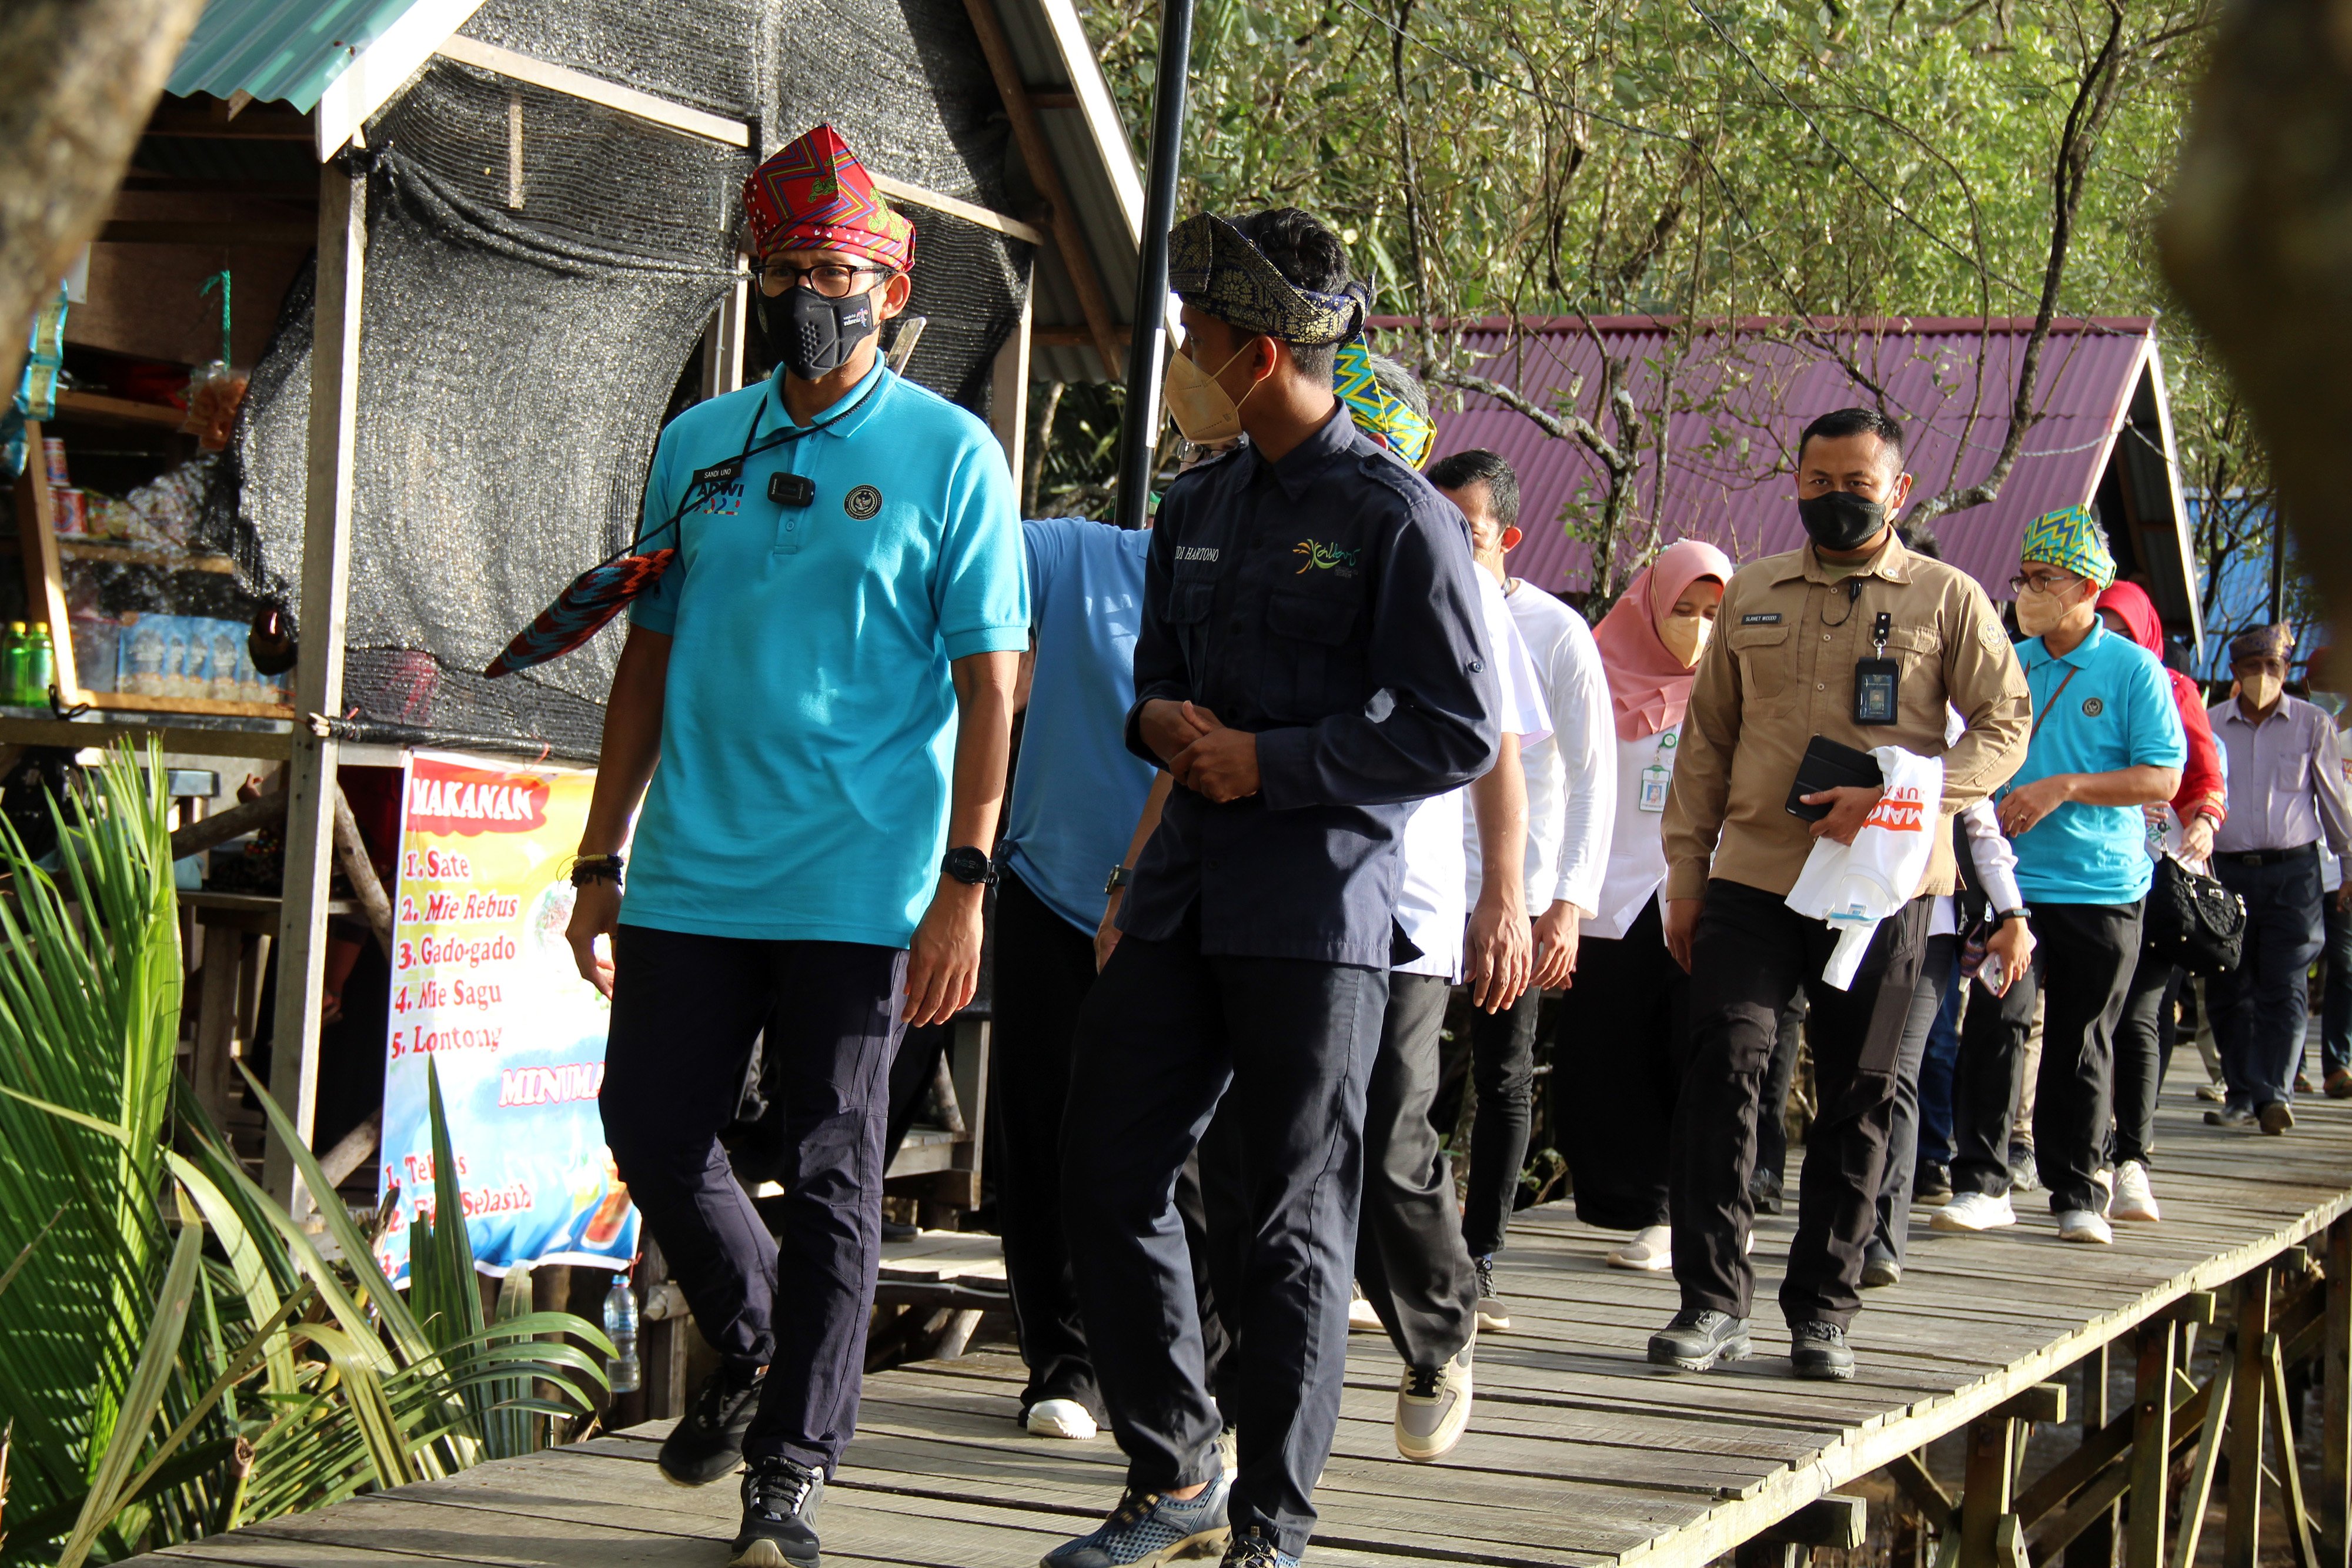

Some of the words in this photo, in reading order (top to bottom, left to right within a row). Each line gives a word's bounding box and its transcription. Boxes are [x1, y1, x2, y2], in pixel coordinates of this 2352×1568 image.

[704, 470, 719, 479] SANDI
[1184, 547, 1219, 562] HARTONO
[406, 853, 424, 878] 1.
[427, 850, 469, 878] Sate
[402, 898, 419, 922] 2.
[425, 894, 459, 921] Mie
[463, 894, 518, 920] Rebus
[397, 942, 417, 969] 3.
[421, 935, 516, 968] Gado-gado
[395, 986, 412, 1014] 4.
[418, 981, 446, 1009] Mie
[453, 979, 502, 1010] Sagu
[392, 1032, 406, 1058] 5.
[413, 1026, 502, 1052] Lontong
[499, 1062, 606, 1108] MINUMA
